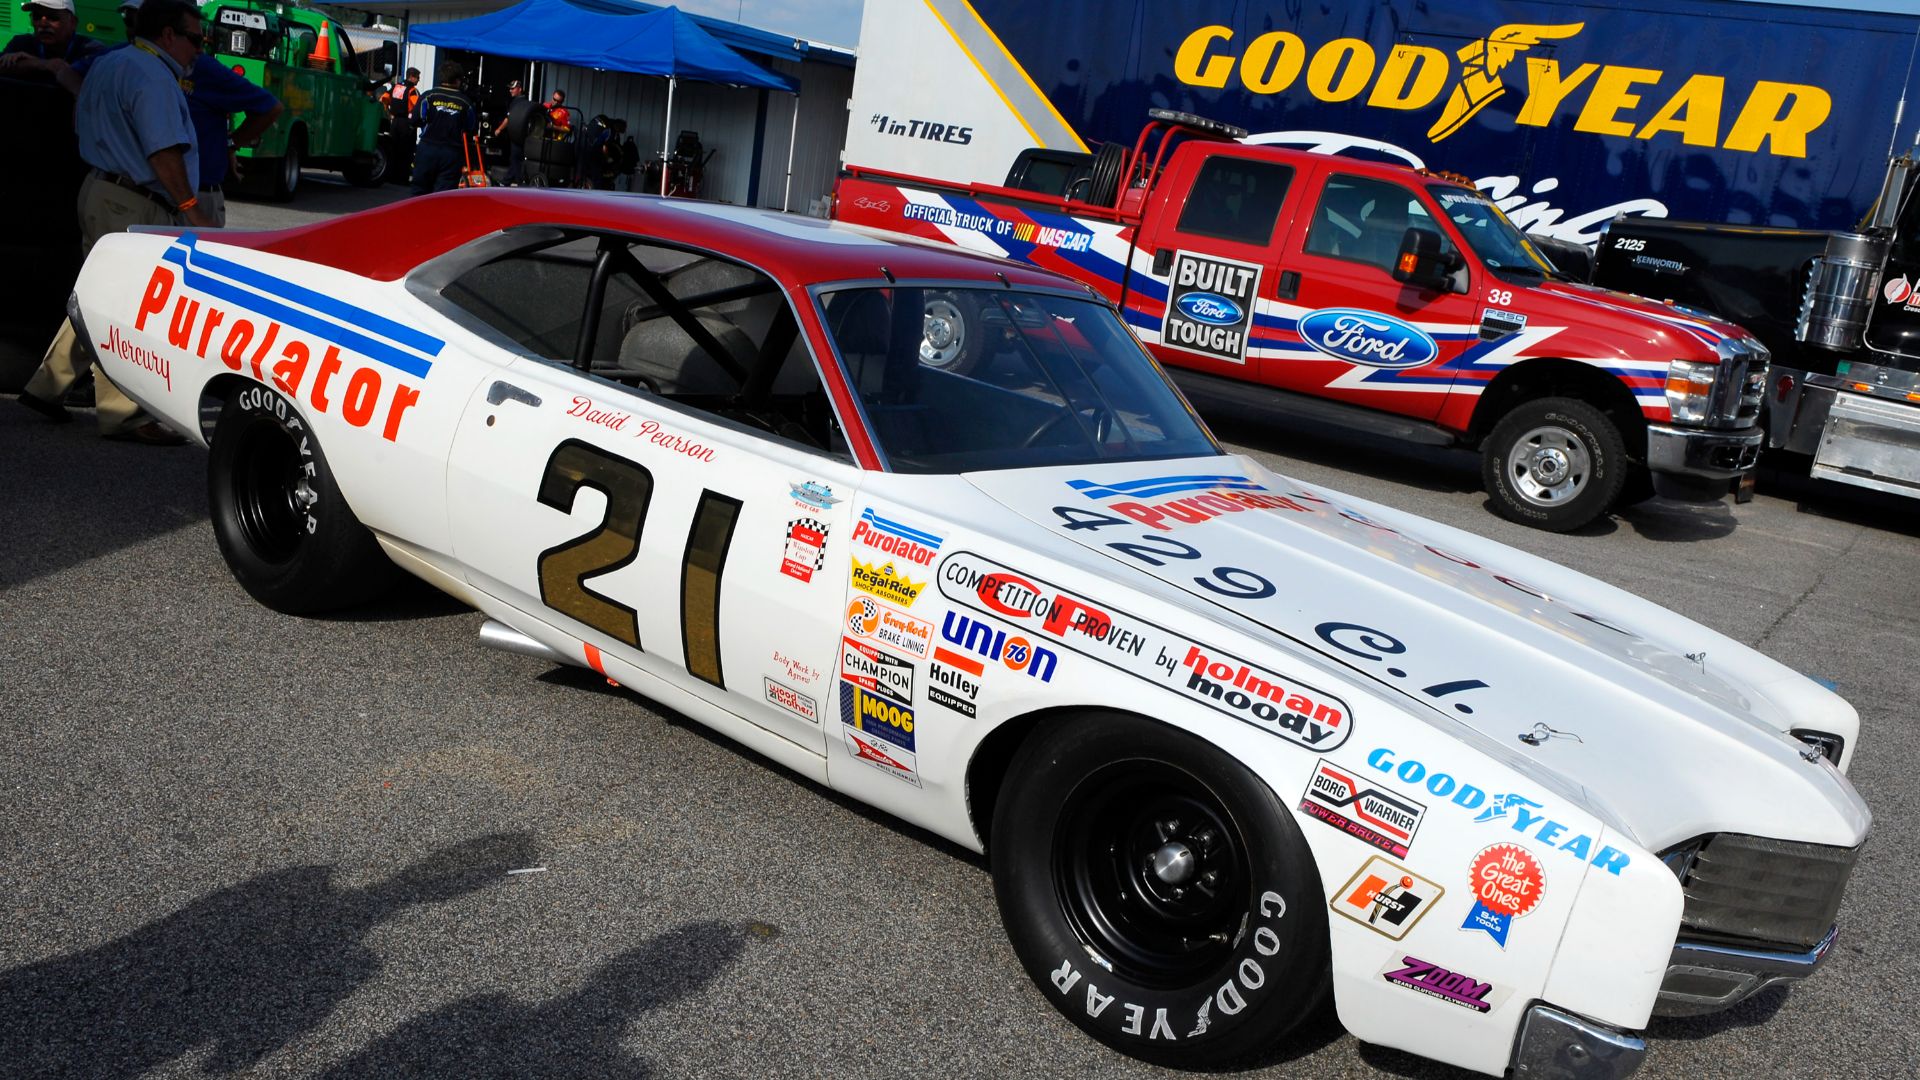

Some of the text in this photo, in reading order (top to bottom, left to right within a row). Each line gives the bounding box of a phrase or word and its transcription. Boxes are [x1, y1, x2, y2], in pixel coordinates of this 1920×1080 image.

[908, 119, 973, 145] TIRES
[903, 203, 1091, 252] OFFICIAL TRUCK OF NASCAR
[1614, 237, 1647, 251] 2125
[1178, 258, 1254, 298] BUILT
[1636, 255, 1683, 271] KENWORTH
[1192, 298, 1228, 319] Ford
[1487, 288, 1513, 306] 38
[1169, 318, 1241, 354] TOUGH
[1323, 315, 1410, 361] Ford
[100, 324, 173, 392] Mercury
[135, 265, 421, 442] Purolator
[567, 395, 718, 463] David Pearson
[1108, 490, 1315, 531] Purolator
[852, 520, 936, 567] Purolator
[537, 437, 744, 692] 21
[855, 581, 908, 605] SHOCK ABSORBERS
[859, 645, 899, 665] EQUIPPED WITH
[878, 628, 925, 654] BRAKE LINING
[946, 562, 1342, 728] COMPETITION PROVEN by holman
[1006, 643, 1027, 662] 76
[773, 651, 820, 680] Body Work by
[845, 653, 909, 690] CHAMPION
[929, 662, 979, 700] Holley
[769, 684, 797, 701] wood
[858, 676, 894, 696] SPARK PLUGS
[778, 692, 814, 717] brothers
[863, 694, 914, 733] MOOG
[929, 690, 975, 715] EQUIPPED
[1186, 671, 1335, 745] moody
[1313, 775, 1347, 798] BORG
[1301, 801, 1346, 827] POWER
[1364, 798, 1415, 832] WARNER
[1481, 861, 1535, 895] Great
[1502, 851, 1526, 875] the
[1366, 889, 1406, 912] HURST
[1481, 880, 1520, 911] Ones
[1475, 915, 1502, 933] TOOLS
[1383, 955, 1493, 1003] ZOOM
[1393, 978, 1480, 1011] GEARS CLUTCHES FLYWHEELS
